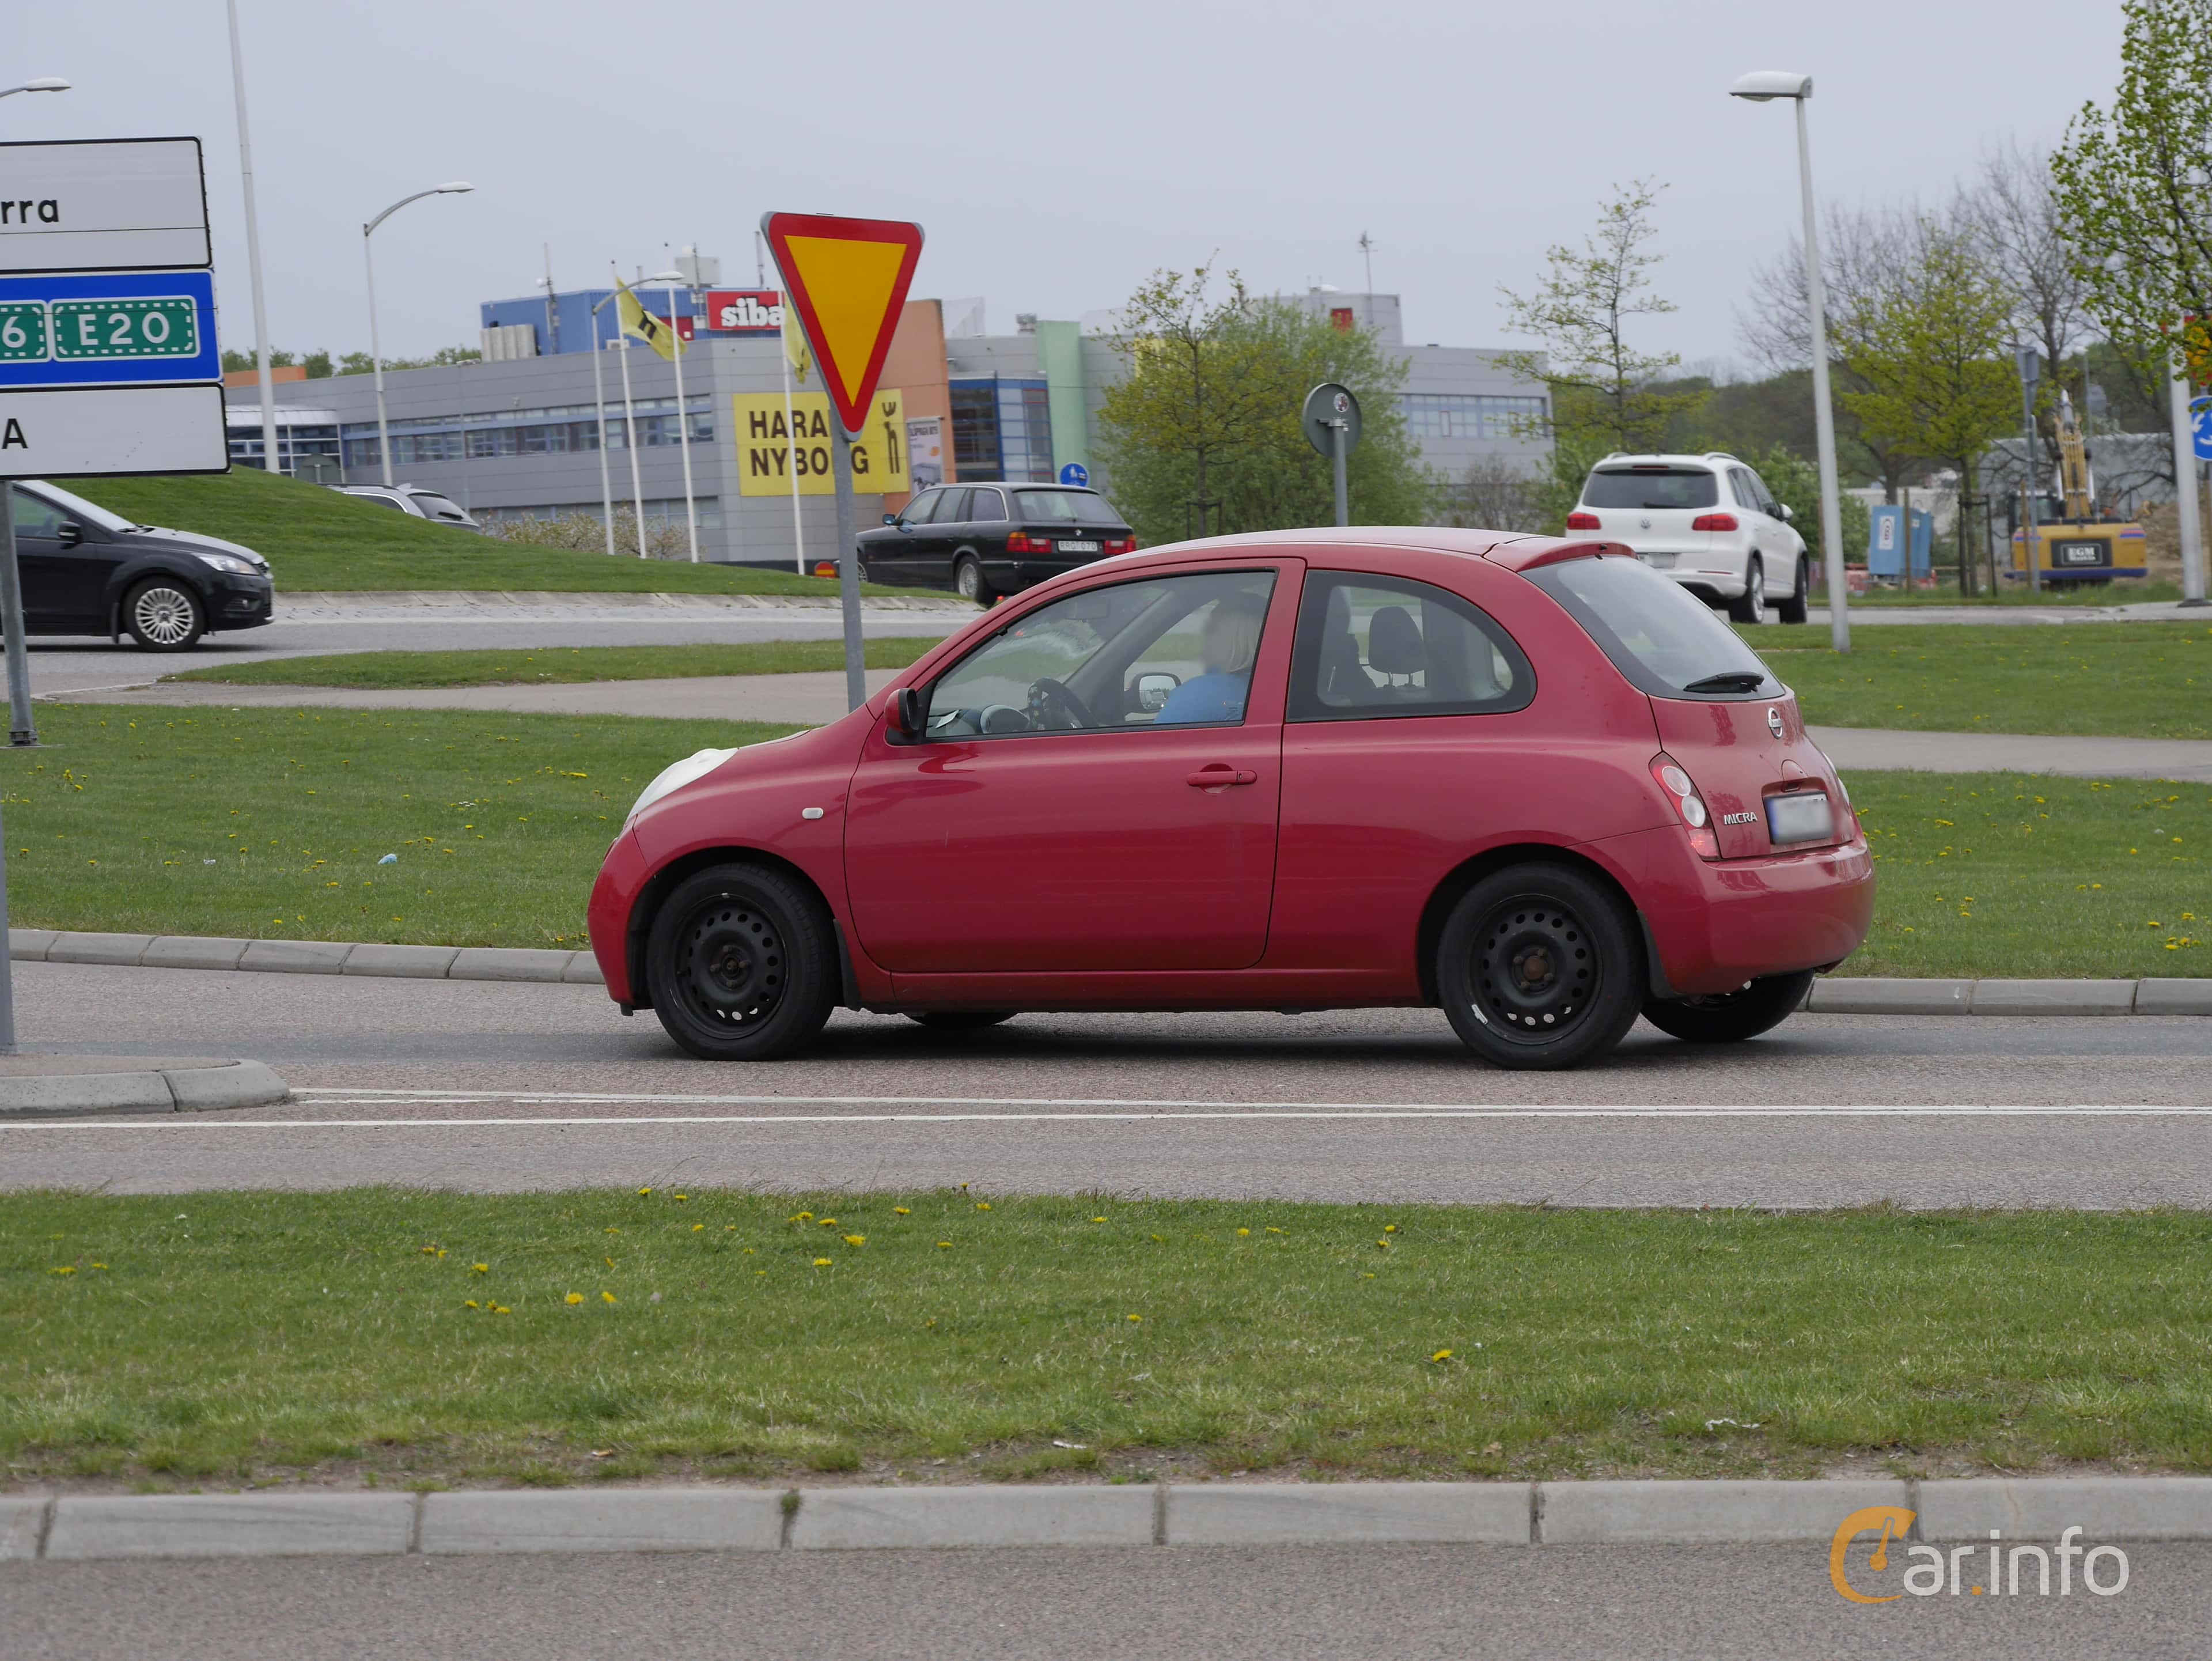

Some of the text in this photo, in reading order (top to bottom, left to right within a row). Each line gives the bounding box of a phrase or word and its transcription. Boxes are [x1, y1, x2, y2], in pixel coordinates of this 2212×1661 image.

[721, 297, 786, 327] siba
[78, 312, 170, 346] E20
[1, 418, 29, 449] A
[749, 409, 831, 438] HARA
[751, 445, 869, 476] NYBOG
[1724, 811, 1758, 825] MICRA
